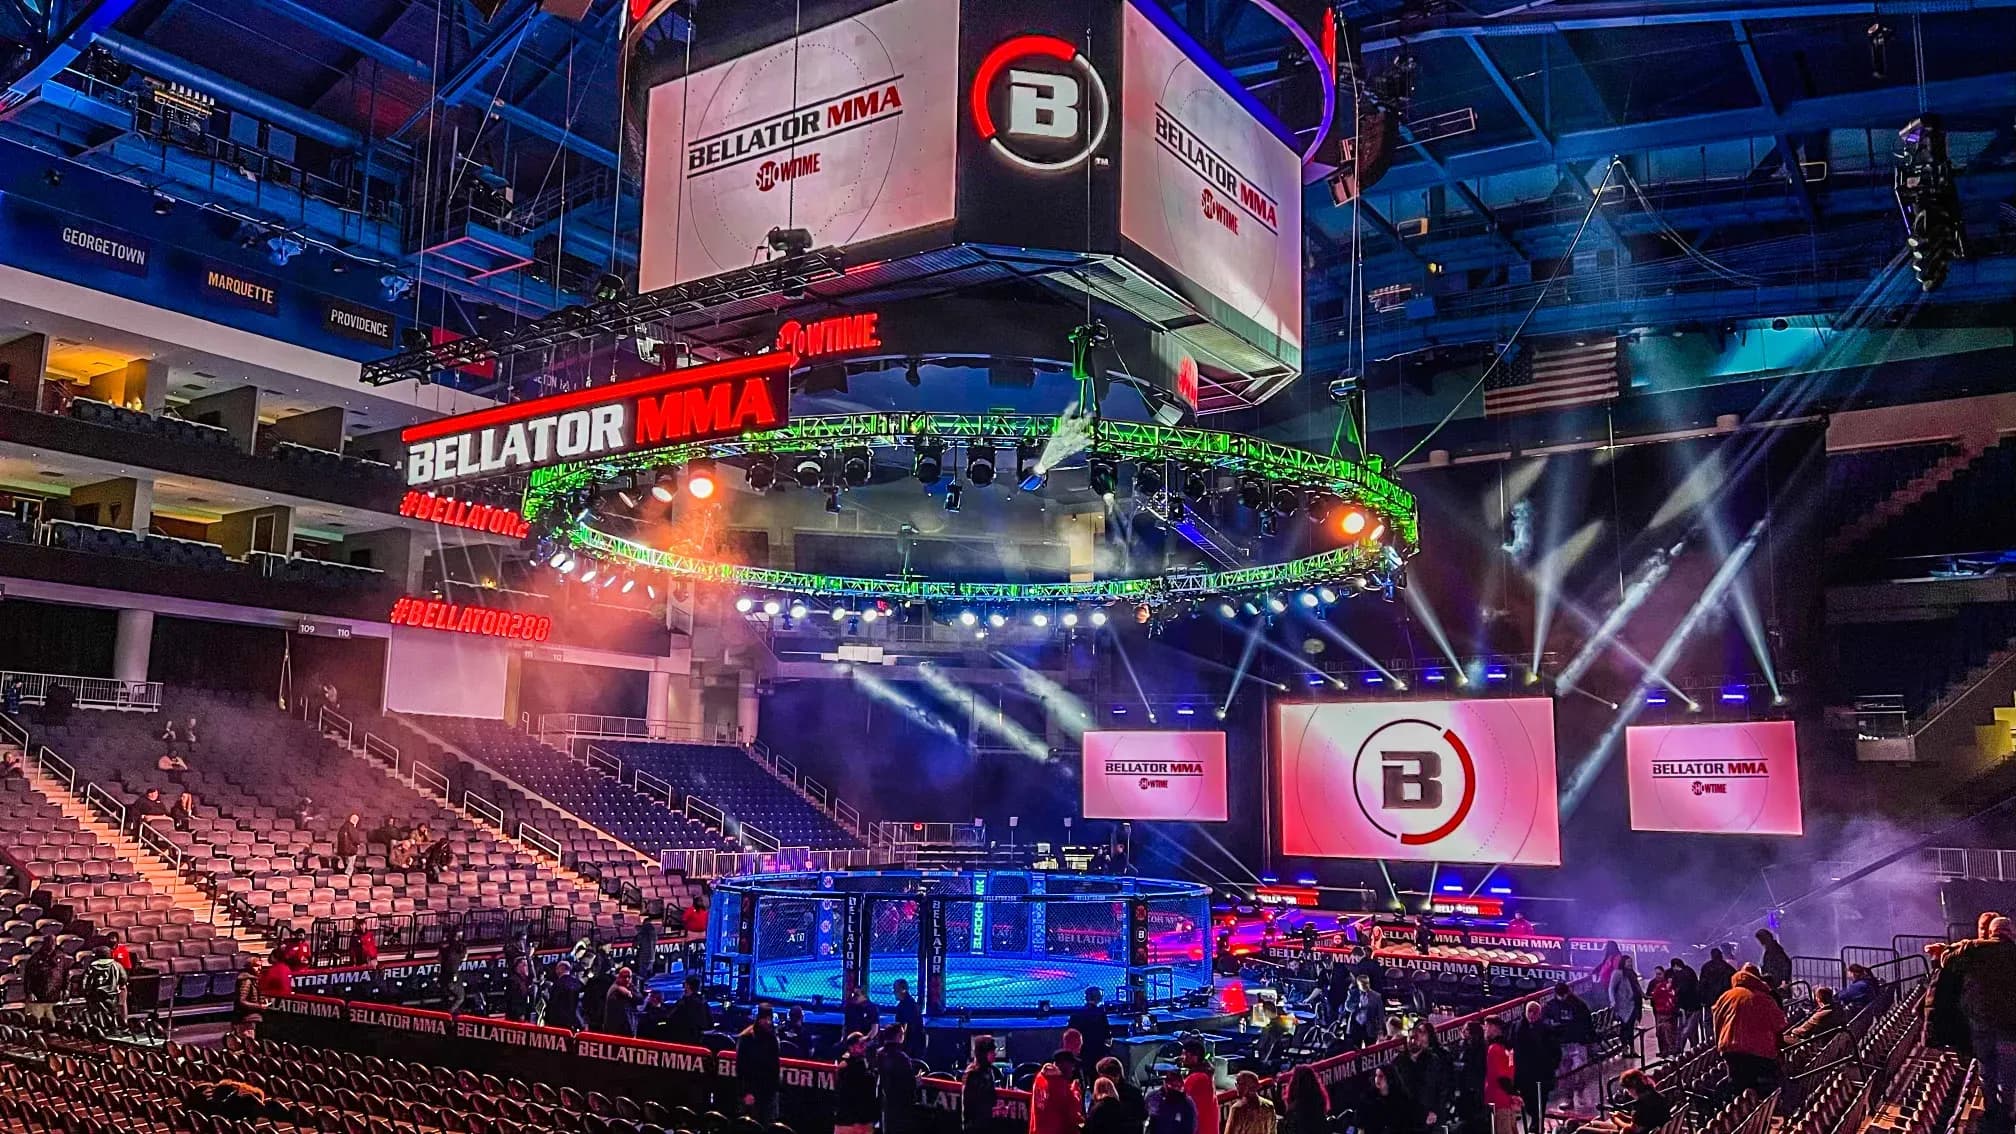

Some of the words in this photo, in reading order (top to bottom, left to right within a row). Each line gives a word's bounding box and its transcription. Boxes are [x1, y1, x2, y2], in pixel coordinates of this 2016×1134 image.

[688, 110, 821, 171] BELLATOR
[827, 85, 903, 129] MMA
[755, 153, 821, 192] SHOWTIME
[1155, 113, 1237, 197] BELLATOR
[1240, 183, 1277, 230] MMA
[1201, 188, 1239, 236] SHOWTIME
[62, 227, 145, 265] GEORGETOWN
[208, 271, 274, 304] MARQUETTE
[331, 308, 389, 338] PROVIDENCE
[407, 403, 624, 486] BELLATOR
[635, 376, 776, 445] MMA
[300, 623, 315, 634] 109
[337, 628, 350, 638] 110
[390, 598, 551, 642] #BELLATOR288
[1105, 762, 1168, 773] BELLATOR
[1170, 763, 1203, 773] MMA
[1652, 763, 1725, 775] BELLATOR
[1727, 762, 1769, 774] MMA
[1691, 780, 1728, 796] SHOWTIME
[1259, 895, 1296, 905] BELLAOR
[973, 880, 985, 949] BLACKHWK
[655, 942, 680, 954] MMA
[932, 901, 942, 974] BELLATOR
[1470, 935, 1529, 947] BELLATOR
[1530, 939, 1562, 949] MMA
[1332, 953, 1354, 965] MM
[1377, 956, 1441, 972] BELLATOR
[1443, 963, 1478, 975] MMA
[1490, 965, 1566, 981] BELLATOR
[331, 971, 371, 985] MMA
[271, 998, 309, 1015] LATOR
[310, 1002, 340, 1019] MMA
[350, 1008, 410, 1031] BELLATOR
[413, 1016, 447, 1035] MMA
[457, 1023, 527, 1046] BELLATOR
[529, 1031, 567, 1053] MMA
[579, 1041, 658, 1066] BELLATOR
[661, 1051, 705, 1073] MMA
